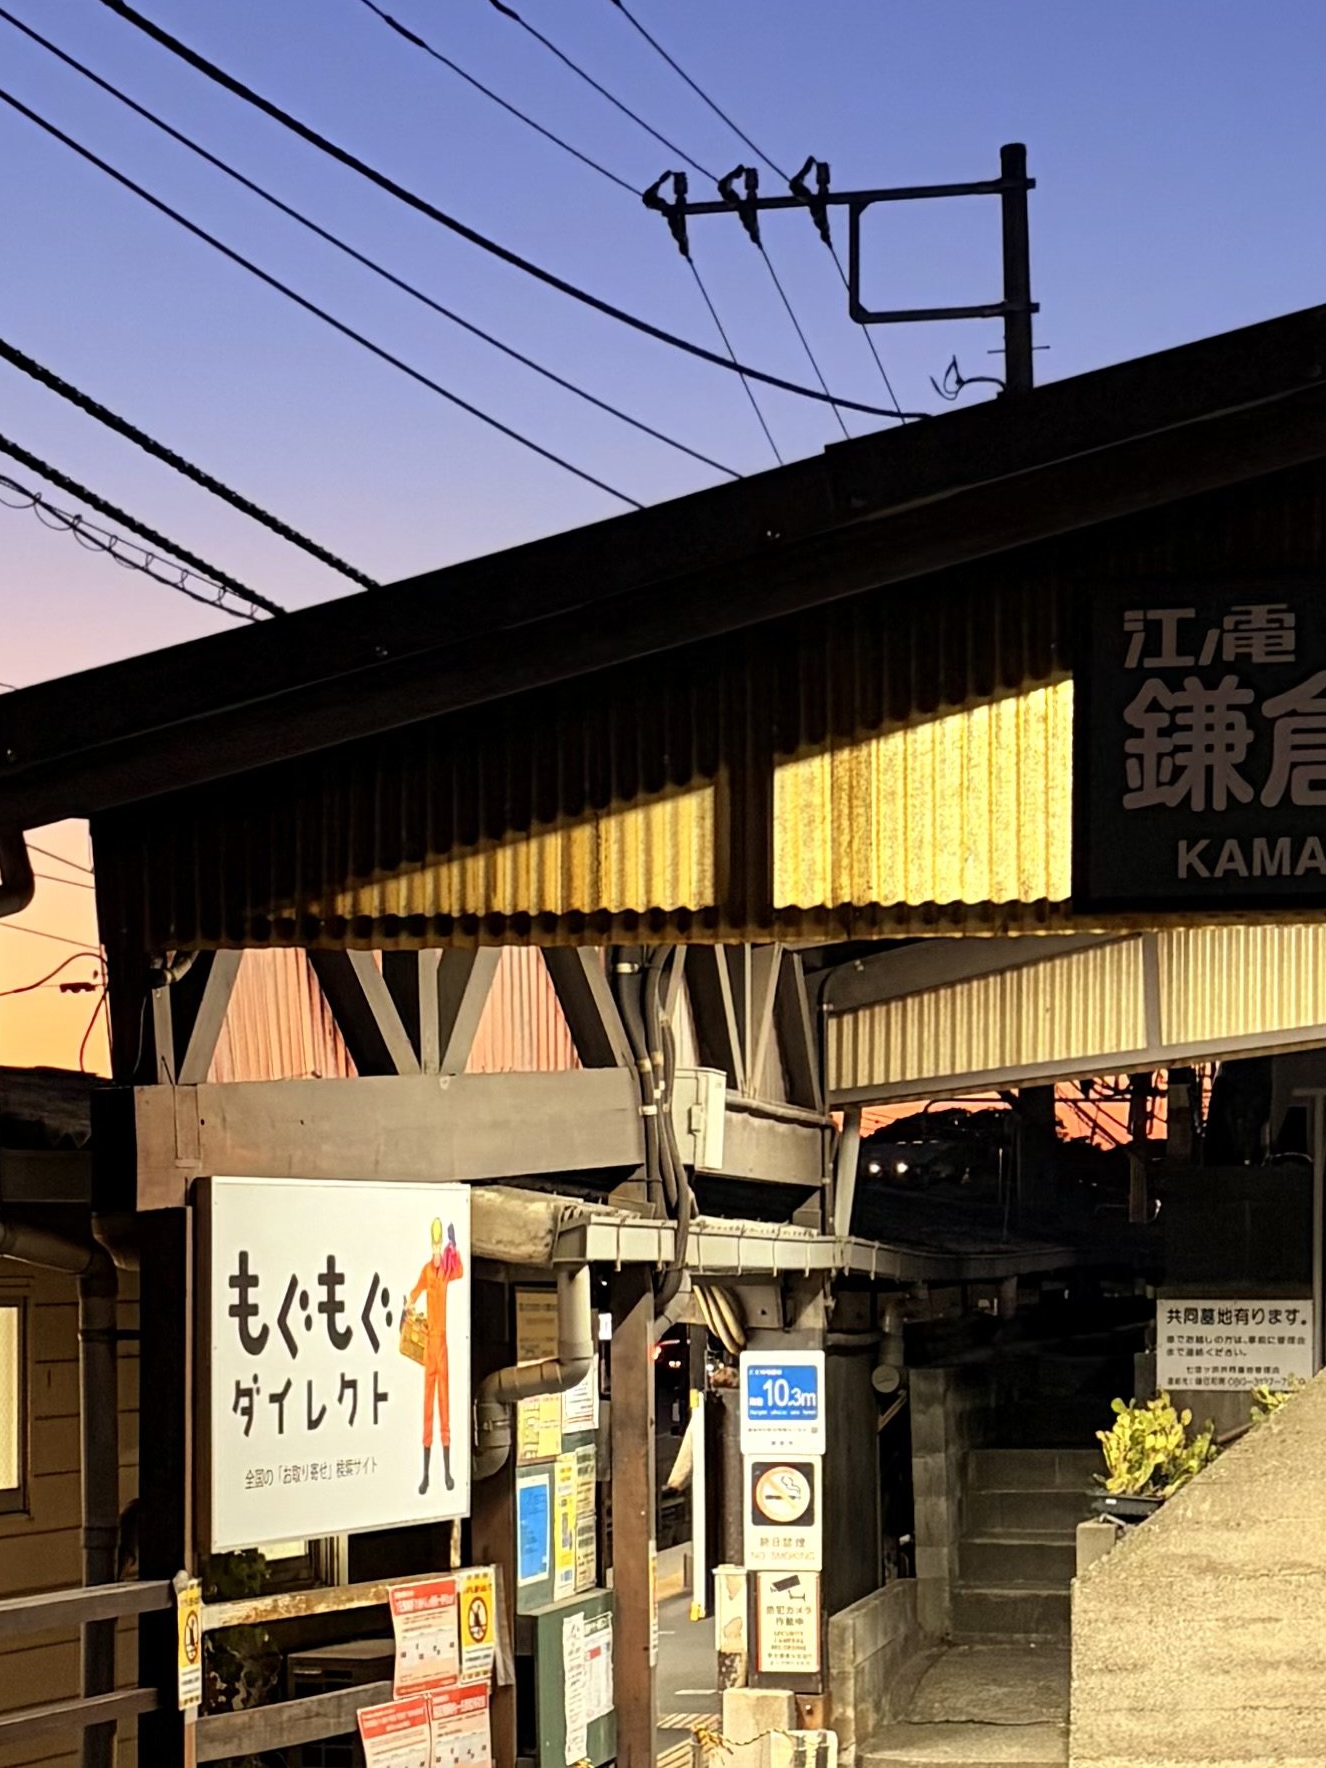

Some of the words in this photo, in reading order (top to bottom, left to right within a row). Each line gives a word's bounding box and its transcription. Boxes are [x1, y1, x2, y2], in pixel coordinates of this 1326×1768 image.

[1123, 603, 1296, 669] 江ノ電
[228, 1250, 393, 1360] もぐもぐ
[1166, 1307, 1307, 1326] 共同墓地有ります。
[232, 1370, 389, 1438] ダイレクト
[762, 1378, 816, 1407] 10.3m
